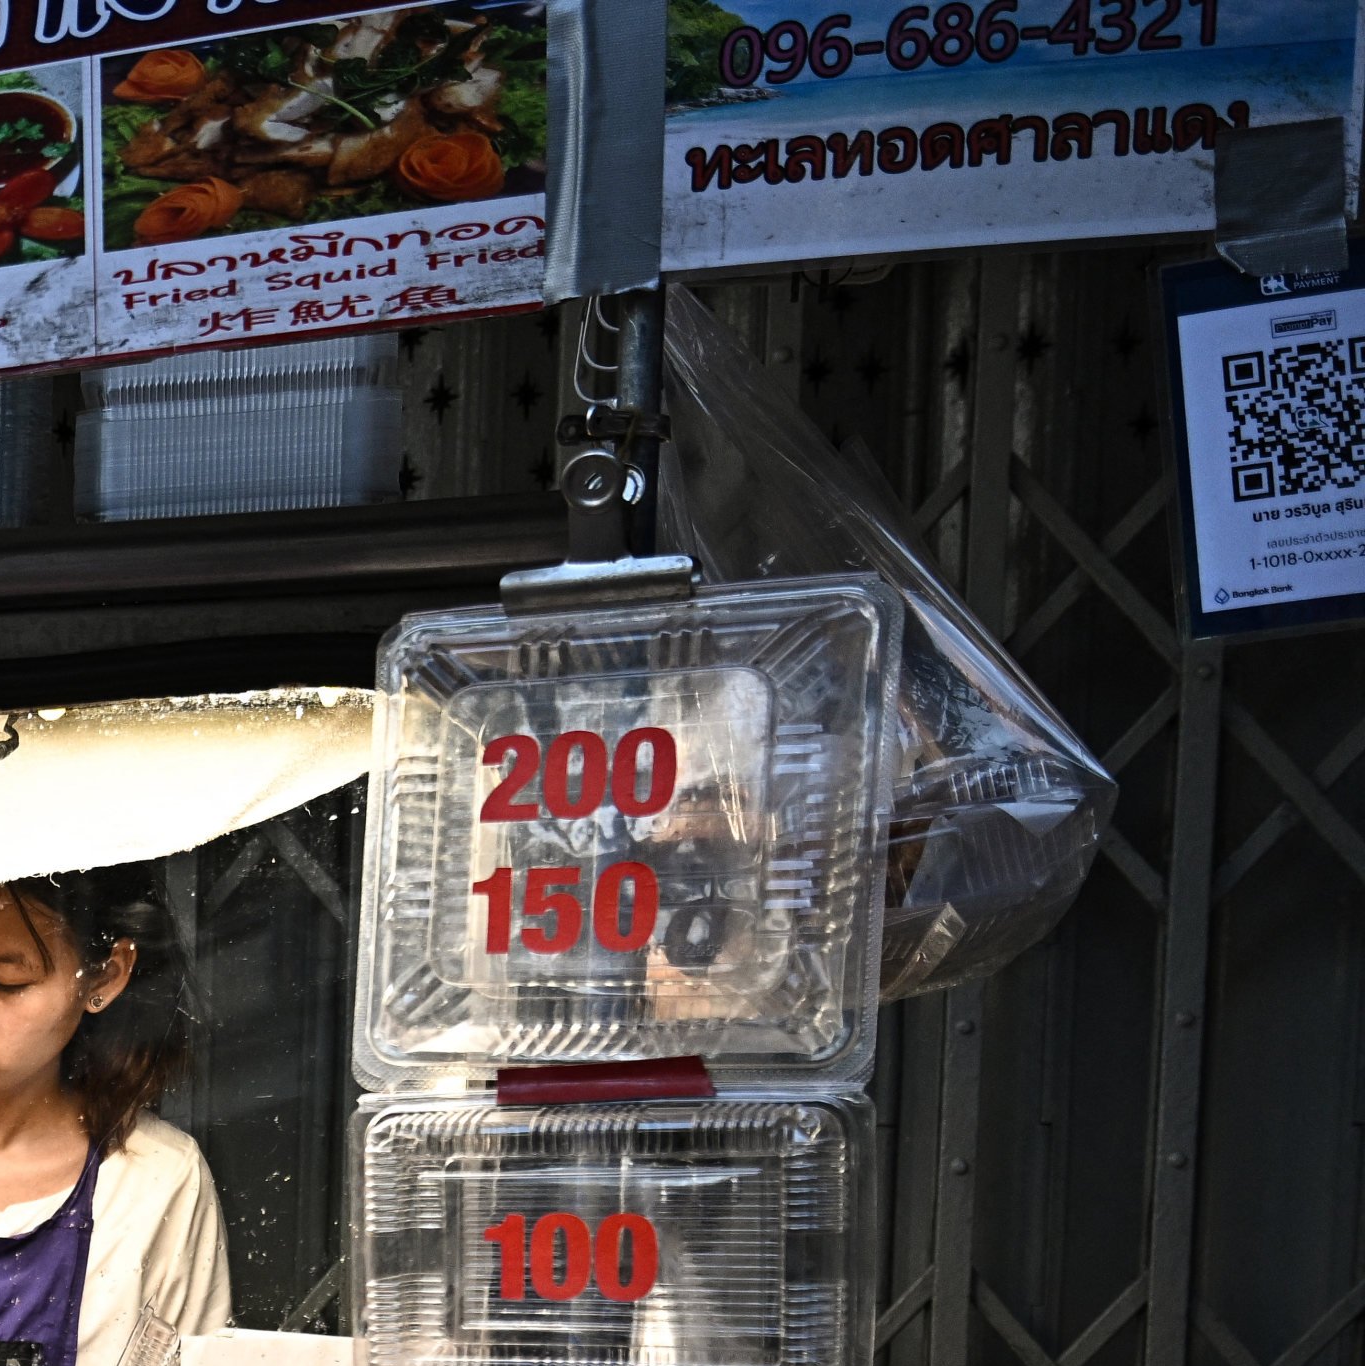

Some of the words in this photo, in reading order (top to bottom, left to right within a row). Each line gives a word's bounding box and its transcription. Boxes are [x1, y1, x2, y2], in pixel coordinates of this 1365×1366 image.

[719, 0, 1218, 89] 096-686-4321
[112, 215, 545, 286] ปลาหมึกทอด
[122, 278, 237, 311] Fried
[265, 258, 397, 291] Squid
[426, 239, 545, 271] Fried
[1293, 276, 1341, 290] PAYMENT
[1253, 508, 1280, 523] นาย
[1232, 586, 1270, 600] Bangkok
[1271, 583, 1293, 595] Bank
[480, 727, 677, 823] 200
[472, 861, 659, 955] 150
[483, 1212, 658, 1301] 100
